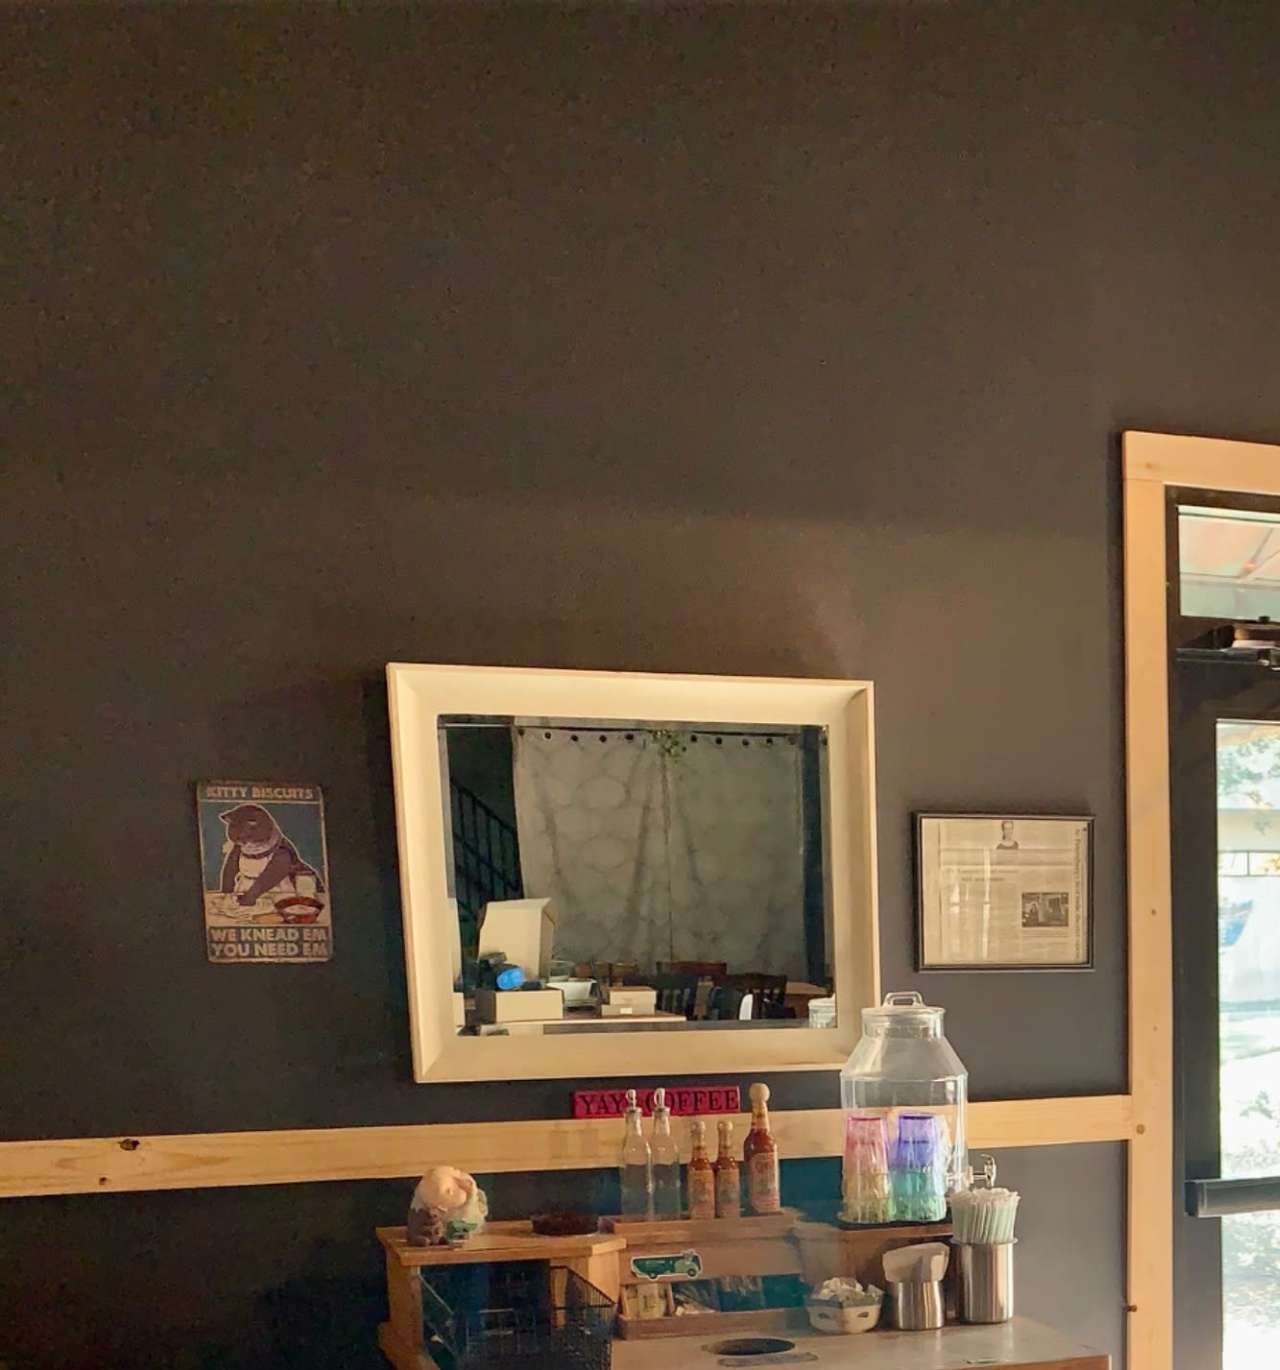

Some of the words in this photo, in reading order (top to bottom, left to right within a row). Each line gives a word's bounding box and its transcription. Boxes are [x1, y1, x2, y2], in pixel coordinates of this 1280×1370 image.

[207, 786, 247, 798] KITTY
[252, 786, 313, 799] BISCUITS
[211, 929, 237, 942] WE
[241, 928, 299, 942] KNEAD
[303, 929, 327, 941] EM
[212, 943, 249, 957] YOU
[254, 943, 299, 957] NEED
[303, 943, 328, 956] EM
